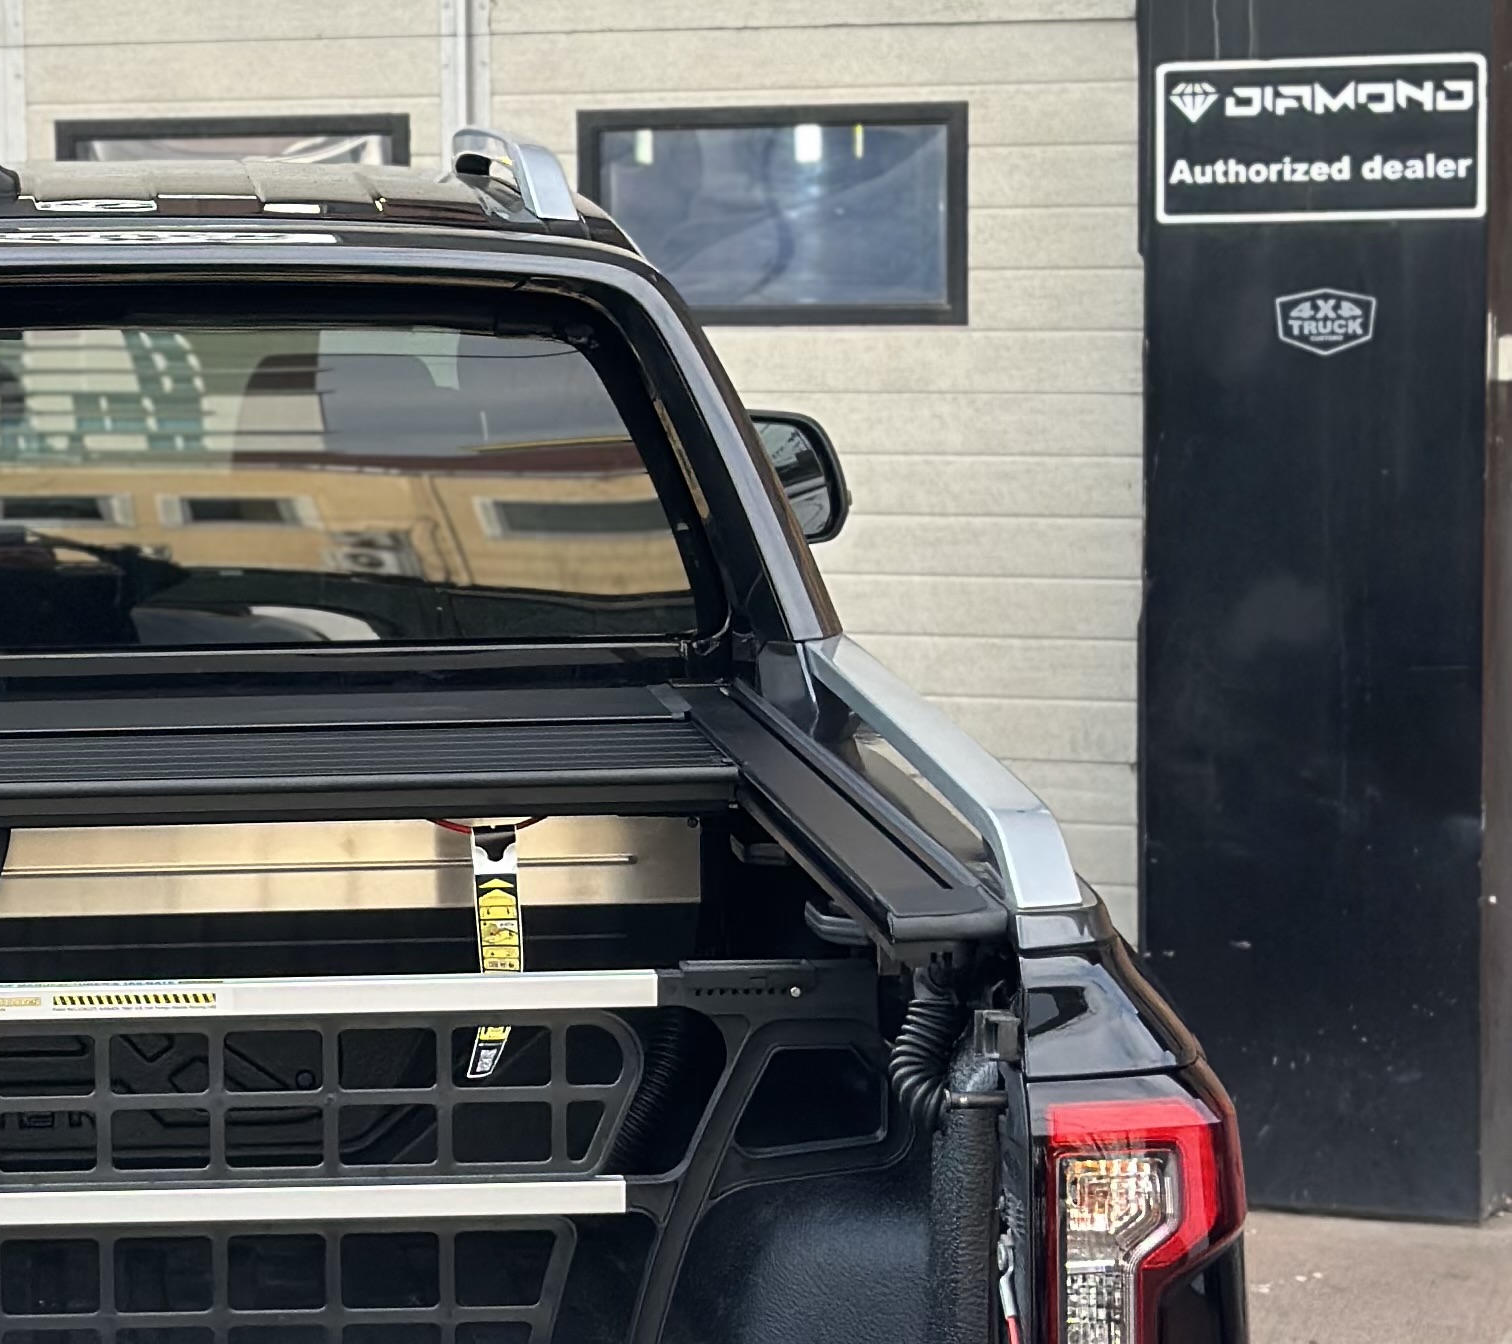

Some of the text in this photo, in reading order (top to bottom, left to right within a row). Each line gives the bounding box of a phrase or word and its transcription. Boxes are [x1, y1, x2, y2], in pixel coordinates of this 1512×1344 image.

[1225, 79, 1474, 117] DIAMOND
[1169, 153, 1473, 184] Authorized dealer
[1288, 318, 1364, 336] TRUCK
